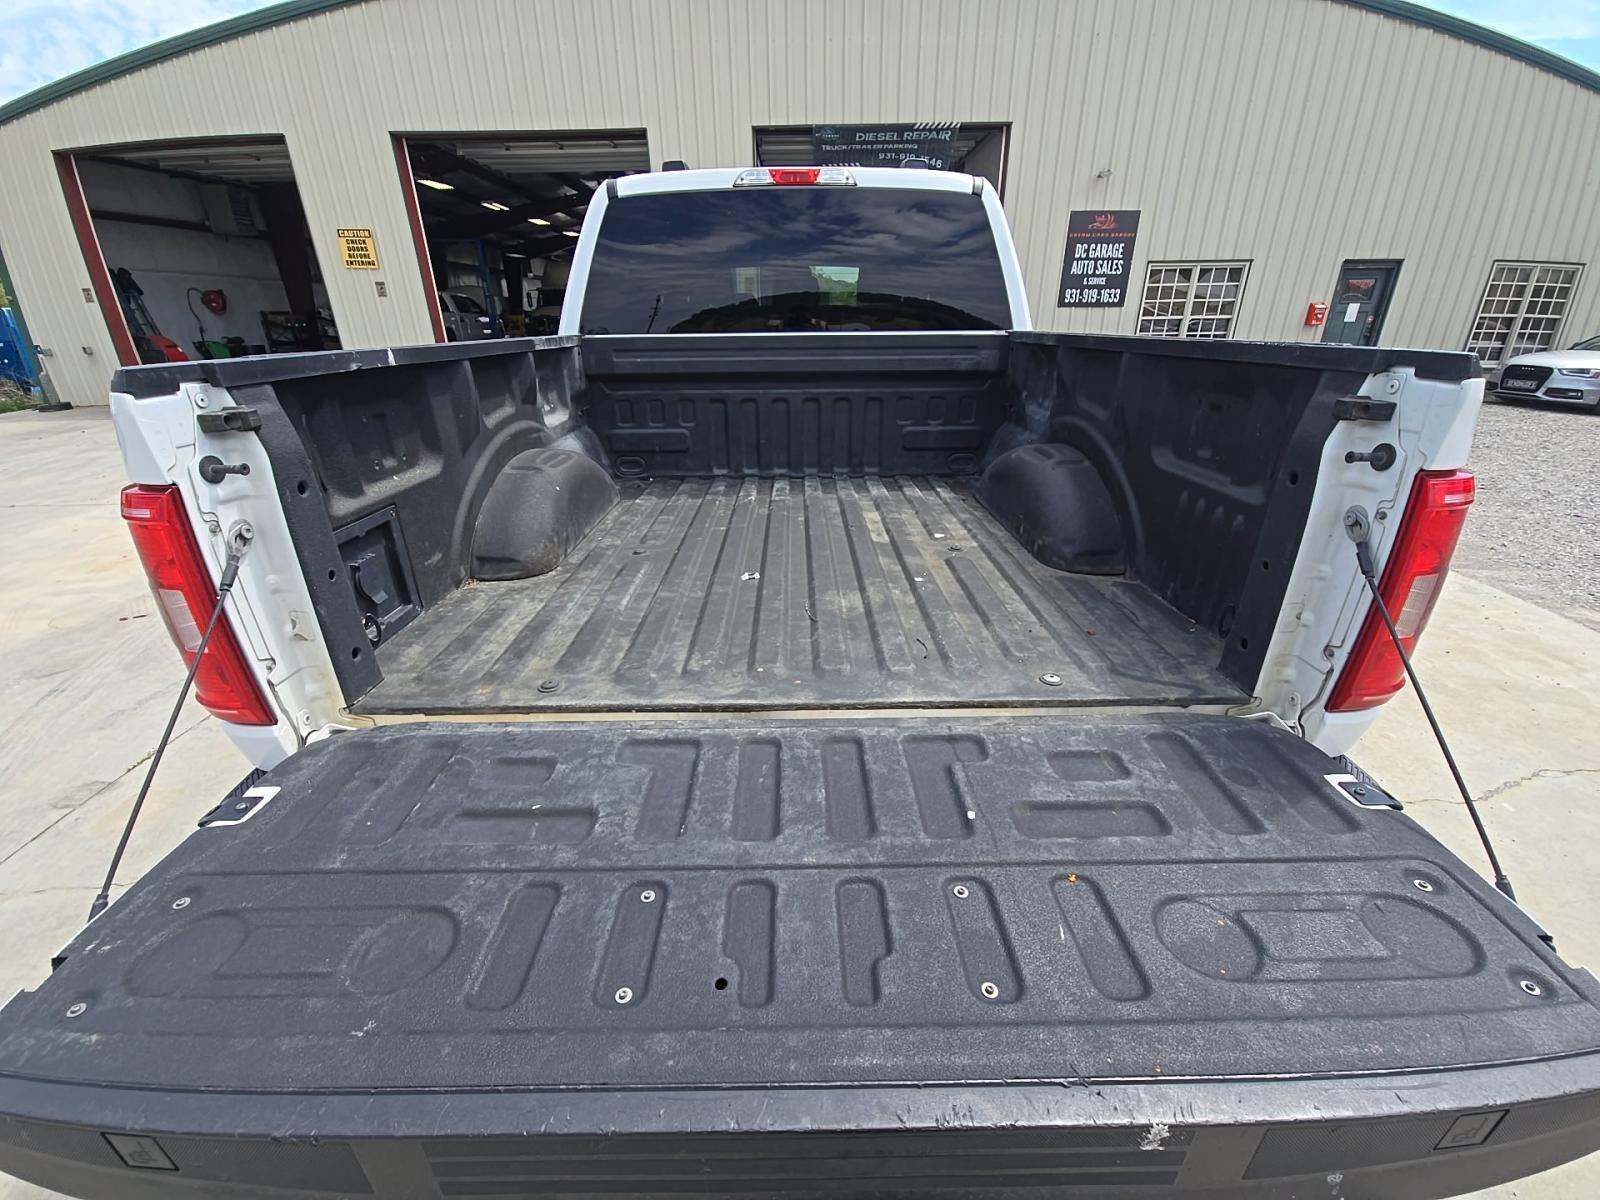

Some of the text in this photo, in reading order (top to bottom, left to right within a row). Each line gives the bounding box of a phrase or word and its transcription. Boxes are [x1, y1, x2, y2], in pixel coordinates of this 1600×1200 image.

[856, 130, 952, 141] DIESEL REPAIR
[1074, 243, 1125, 258] DC GARAGE
[1070, 260, 1124, 275] AUTO SALES
[1083, 277, 1107, 285] & SERVICE
[1064, 288, 1121, 304] 931-919-1633
